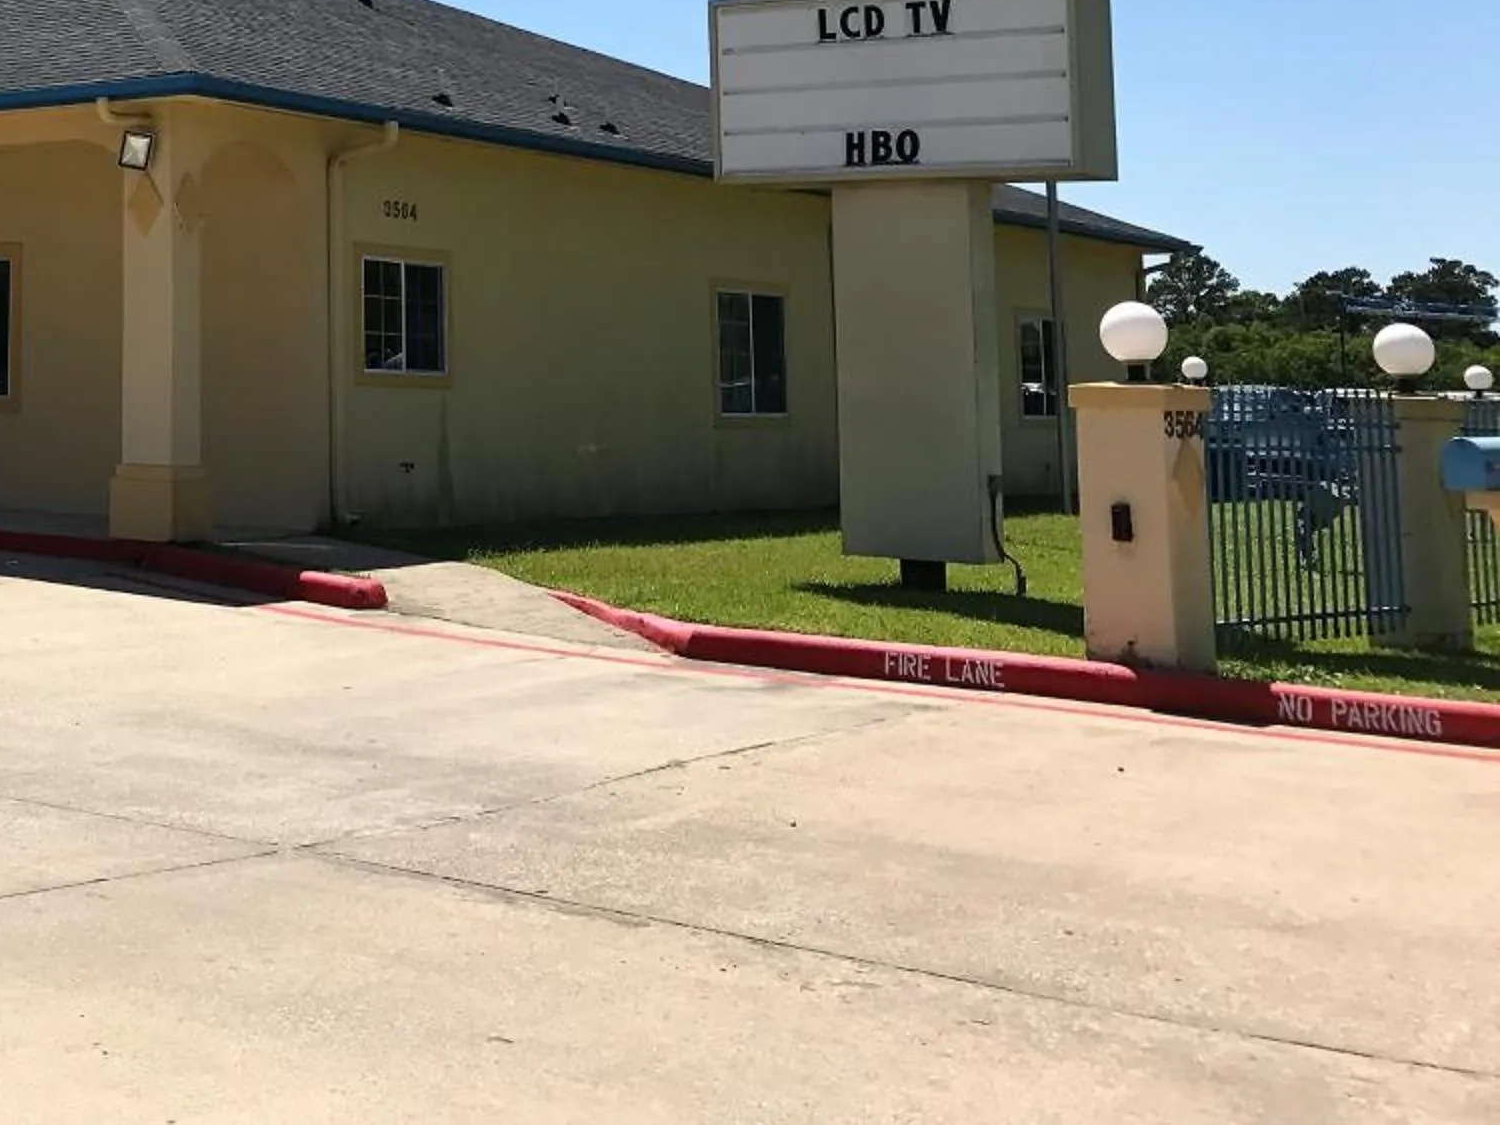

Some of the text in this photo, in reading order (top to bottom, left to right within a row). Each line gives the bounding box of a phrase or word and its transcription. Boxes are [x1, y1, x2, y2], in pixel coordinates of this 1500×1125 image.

[818, 4, 885, 40] LCD
[845, 129, 920, 165] HBO
[884, 650, 1005, 687] FIRE LANE
[1278, 691, 1443, 736] NO PARKING
